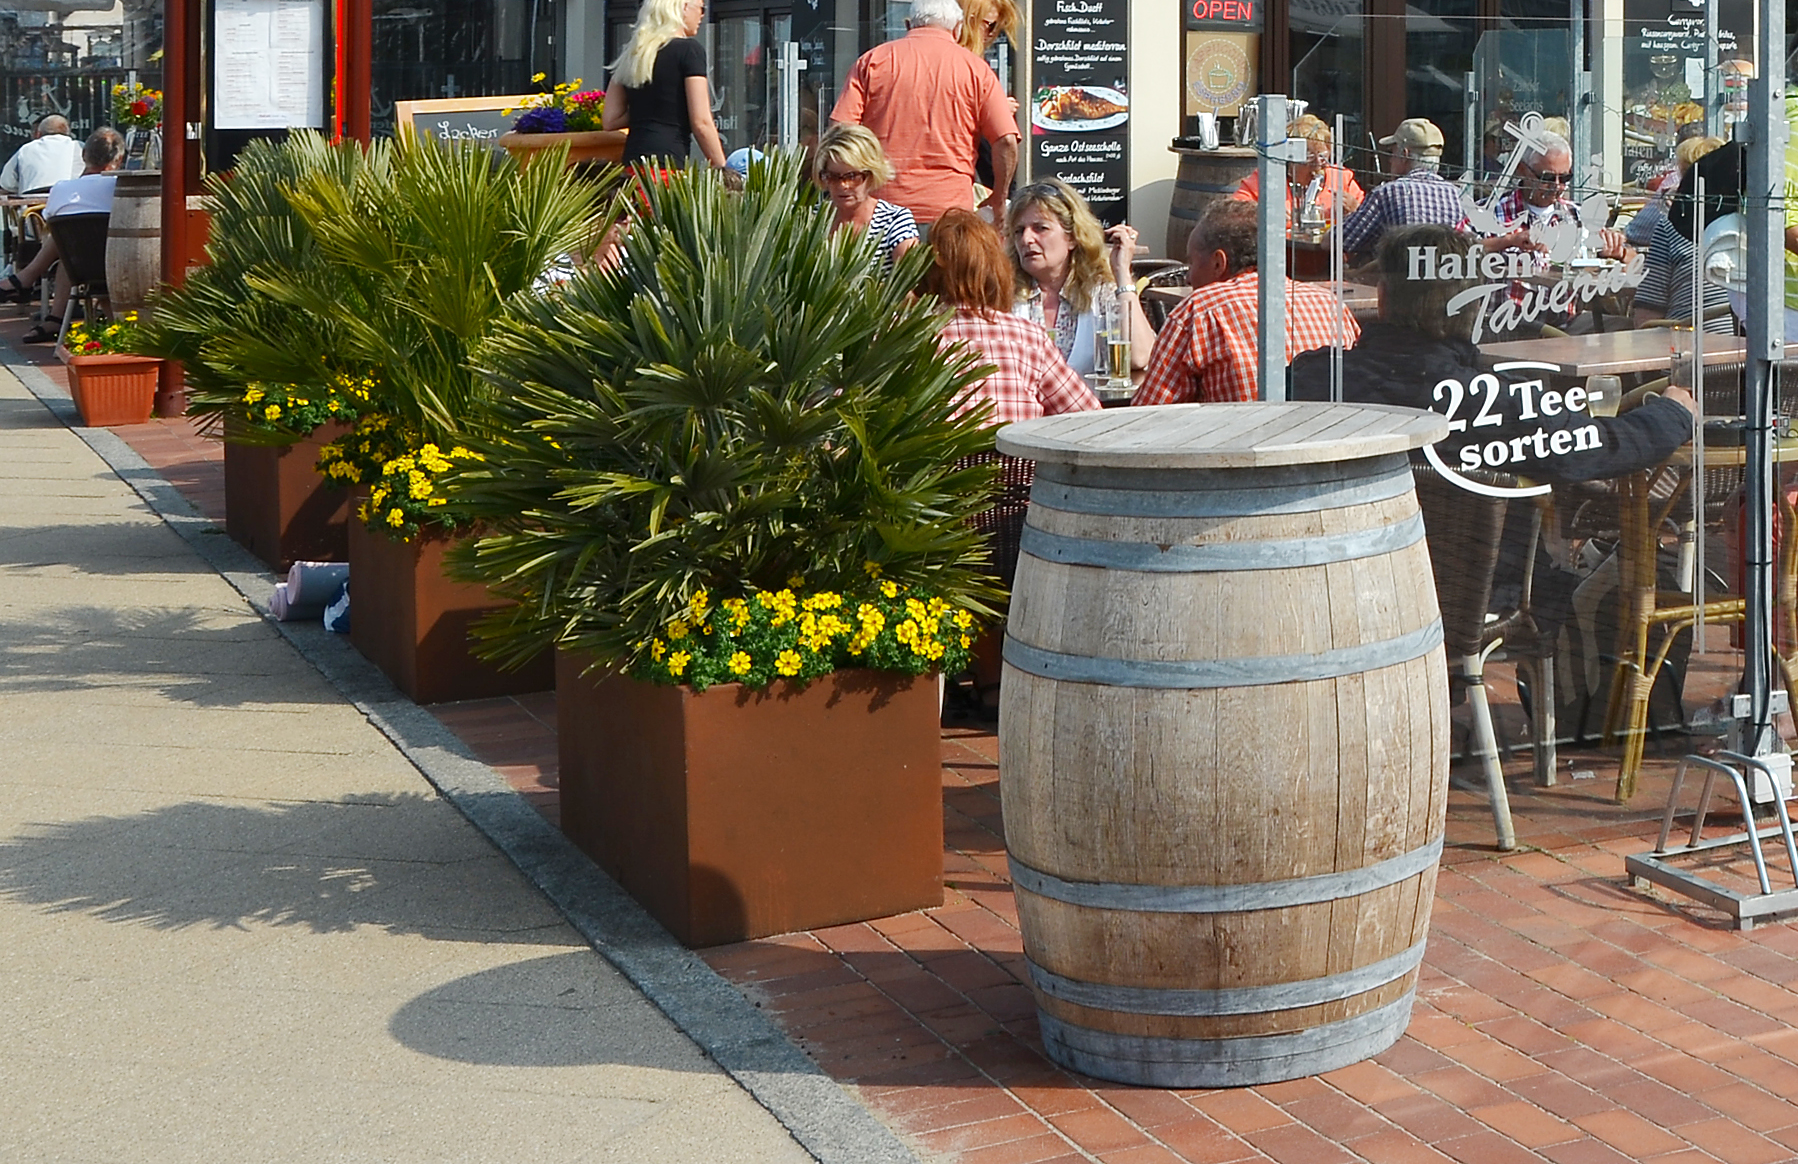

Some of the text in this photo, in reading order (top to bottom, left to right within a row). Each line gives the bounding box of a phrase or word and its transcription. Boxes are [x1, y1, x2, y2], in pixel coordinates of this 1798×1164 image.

[1193, 0, 1253, 20] OPEN
[1040, 140, 1122, 157] Ganze Ostseescholle
[1407, 244, 1534, 280] Hafen
[1446, 253, 1651, 345] Taverne
[1433, 373, 1604, 432] 22 Tee-
[1459, 424, 1603, 472] sorten
